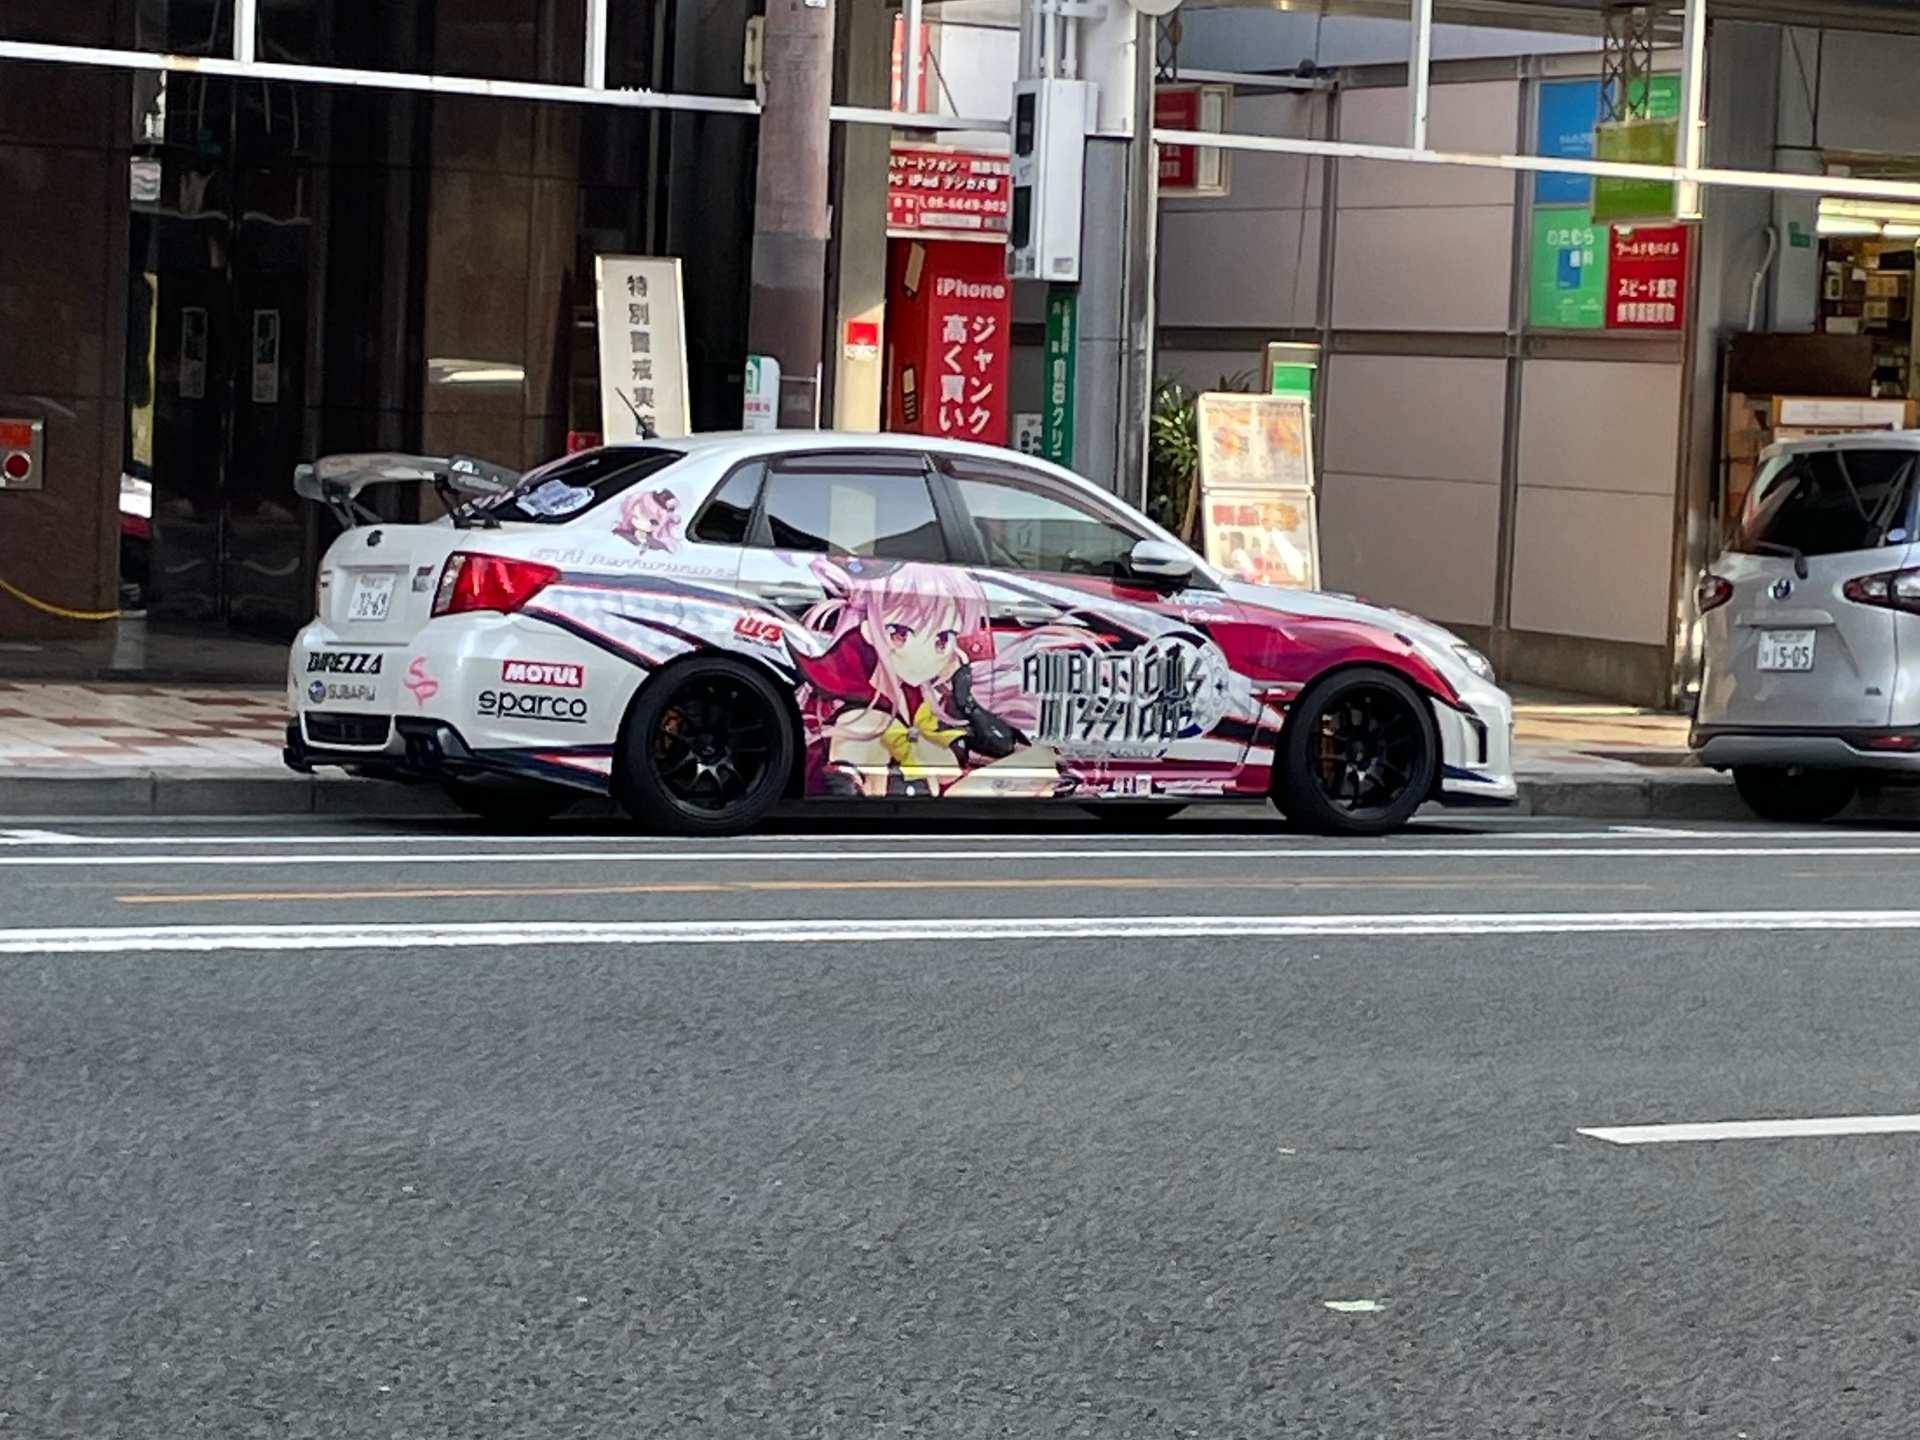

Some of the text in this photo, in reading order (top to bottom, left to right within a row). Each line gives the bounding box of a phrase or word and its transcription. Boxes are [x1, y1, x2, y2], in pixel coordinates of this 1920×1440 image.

[936, 276, 1006, 300] iPhone
[938, 313, 968, 432] 高く買い
[967, 315, 996, 434] ジャンク
[307, 652, 384, 675] DIREZZA
[504, 662, 580, 685] MOTUL
[1022, 642, 1207, 697] AMBITIOUS
[327, 684, 377, 701] SUBARU
[478, 689, 588, 718] sparco
